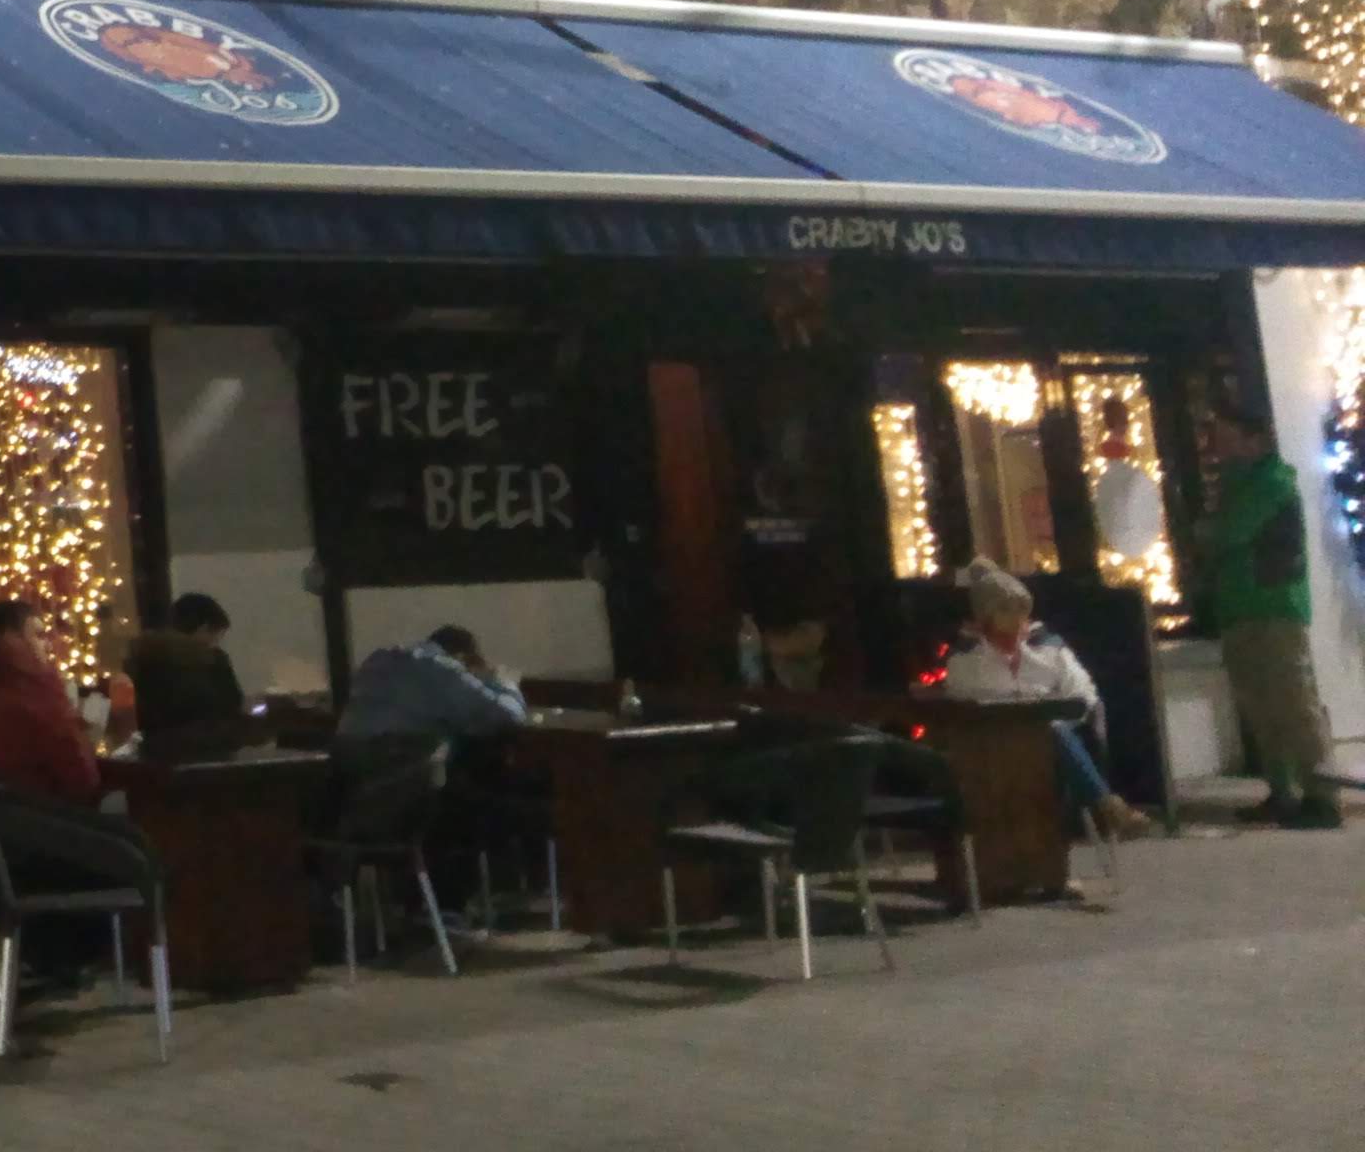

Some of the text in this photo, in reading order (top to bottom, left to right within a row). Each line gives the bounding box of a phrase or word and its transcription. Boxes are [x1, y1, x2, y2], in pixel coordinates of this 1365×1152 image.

[61, 4, 254, 66] CRABBY
[788, 215, 897, 250] CRABBY
[341, 372, 499, 438] FREE
[422, 463, 573, 531] BEER
